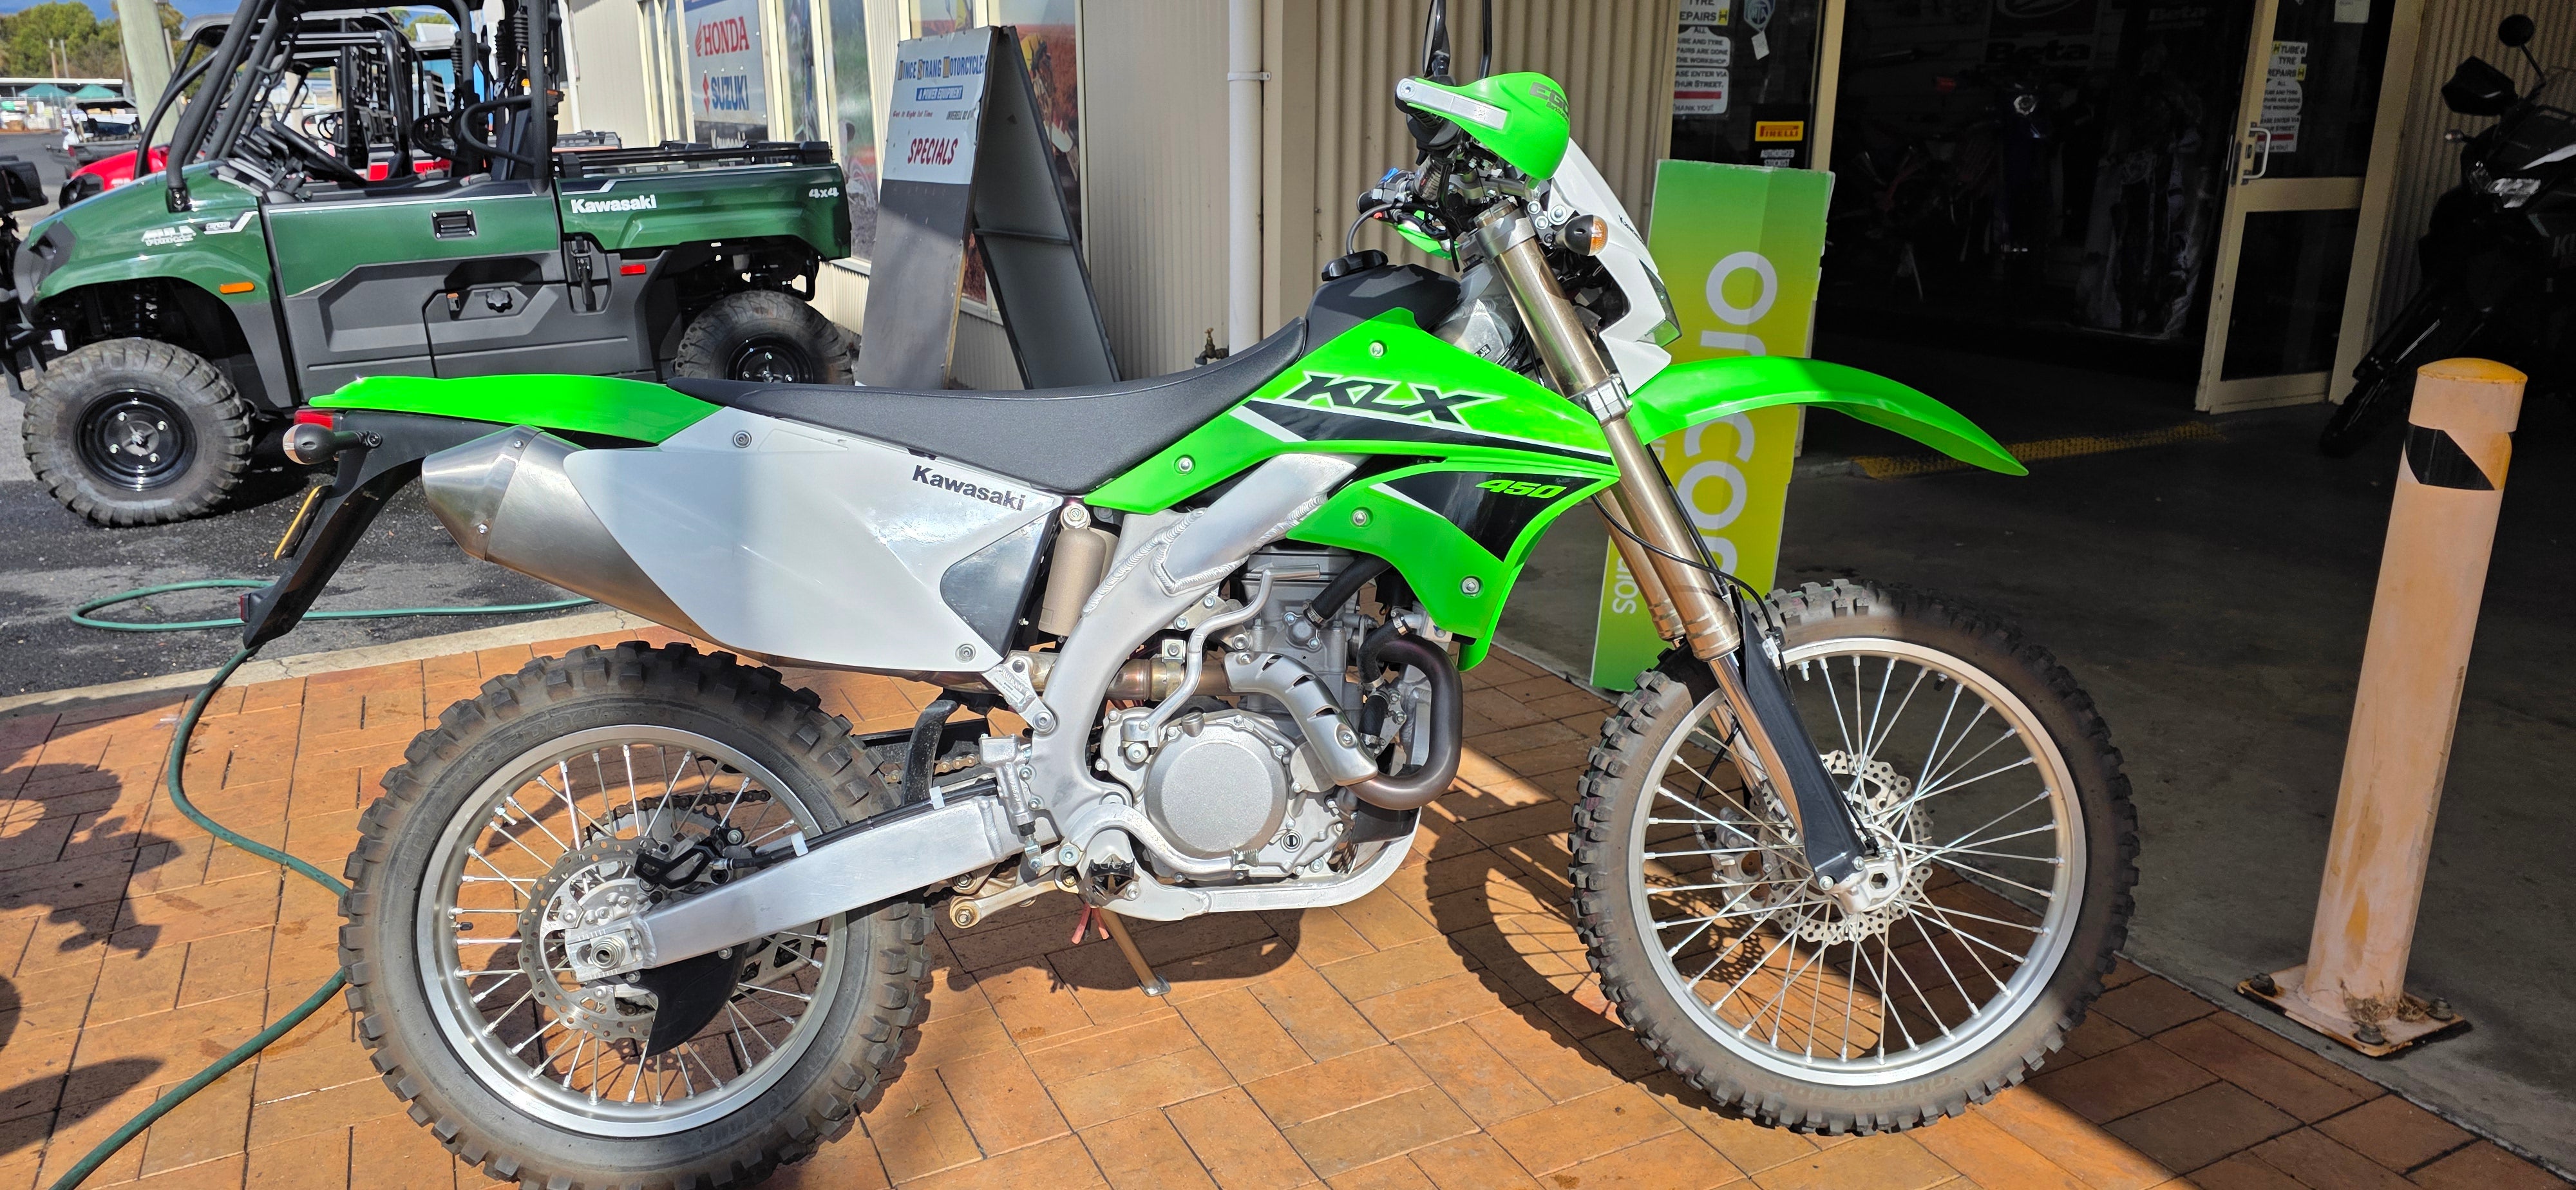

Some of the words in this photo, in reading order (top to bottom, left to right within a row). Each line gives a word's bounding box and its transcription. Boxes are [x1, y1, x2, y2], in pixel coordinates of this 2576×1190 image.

[1679, 11, 1716, 21] EPAIRS
[703, 15, 750, 56] HONDA
[711, 75, 750, 111] SUZUKI
[1760, 125, 1799, 137] PIRELLI
[907, 137, 958, 165] SPECIALS
[571, 194, 658, 214] Kawasaki
[808, 187, 840, 198] 4x4
[1282, 372, 1499, 430] KLX
[912, 464, 1026, 511] Kawasaki
[1476, 479, 1568, 499] 450
